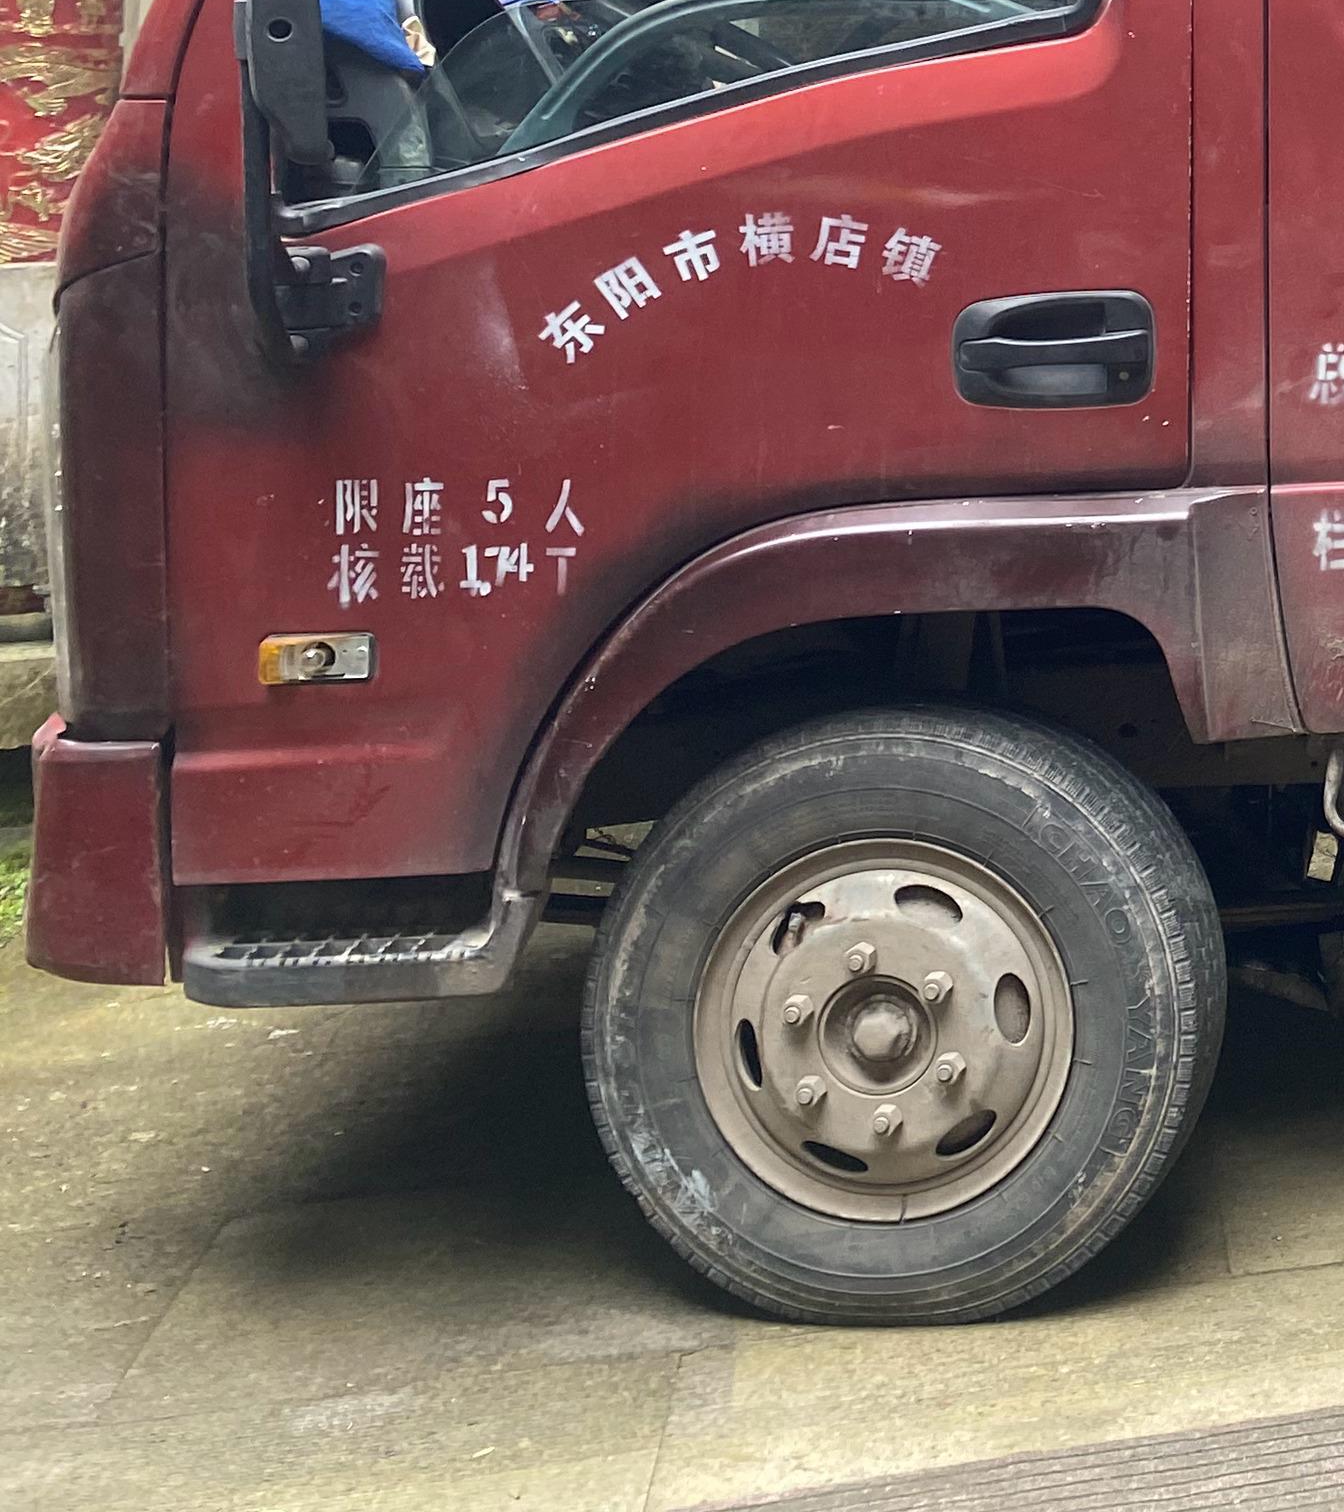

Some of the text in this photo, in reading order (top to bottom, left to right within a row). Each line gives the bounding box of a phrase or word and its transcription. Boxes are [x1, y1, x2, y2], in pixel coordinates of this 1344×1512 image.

[538, 211, 942, 365] 东阳市横店镇
